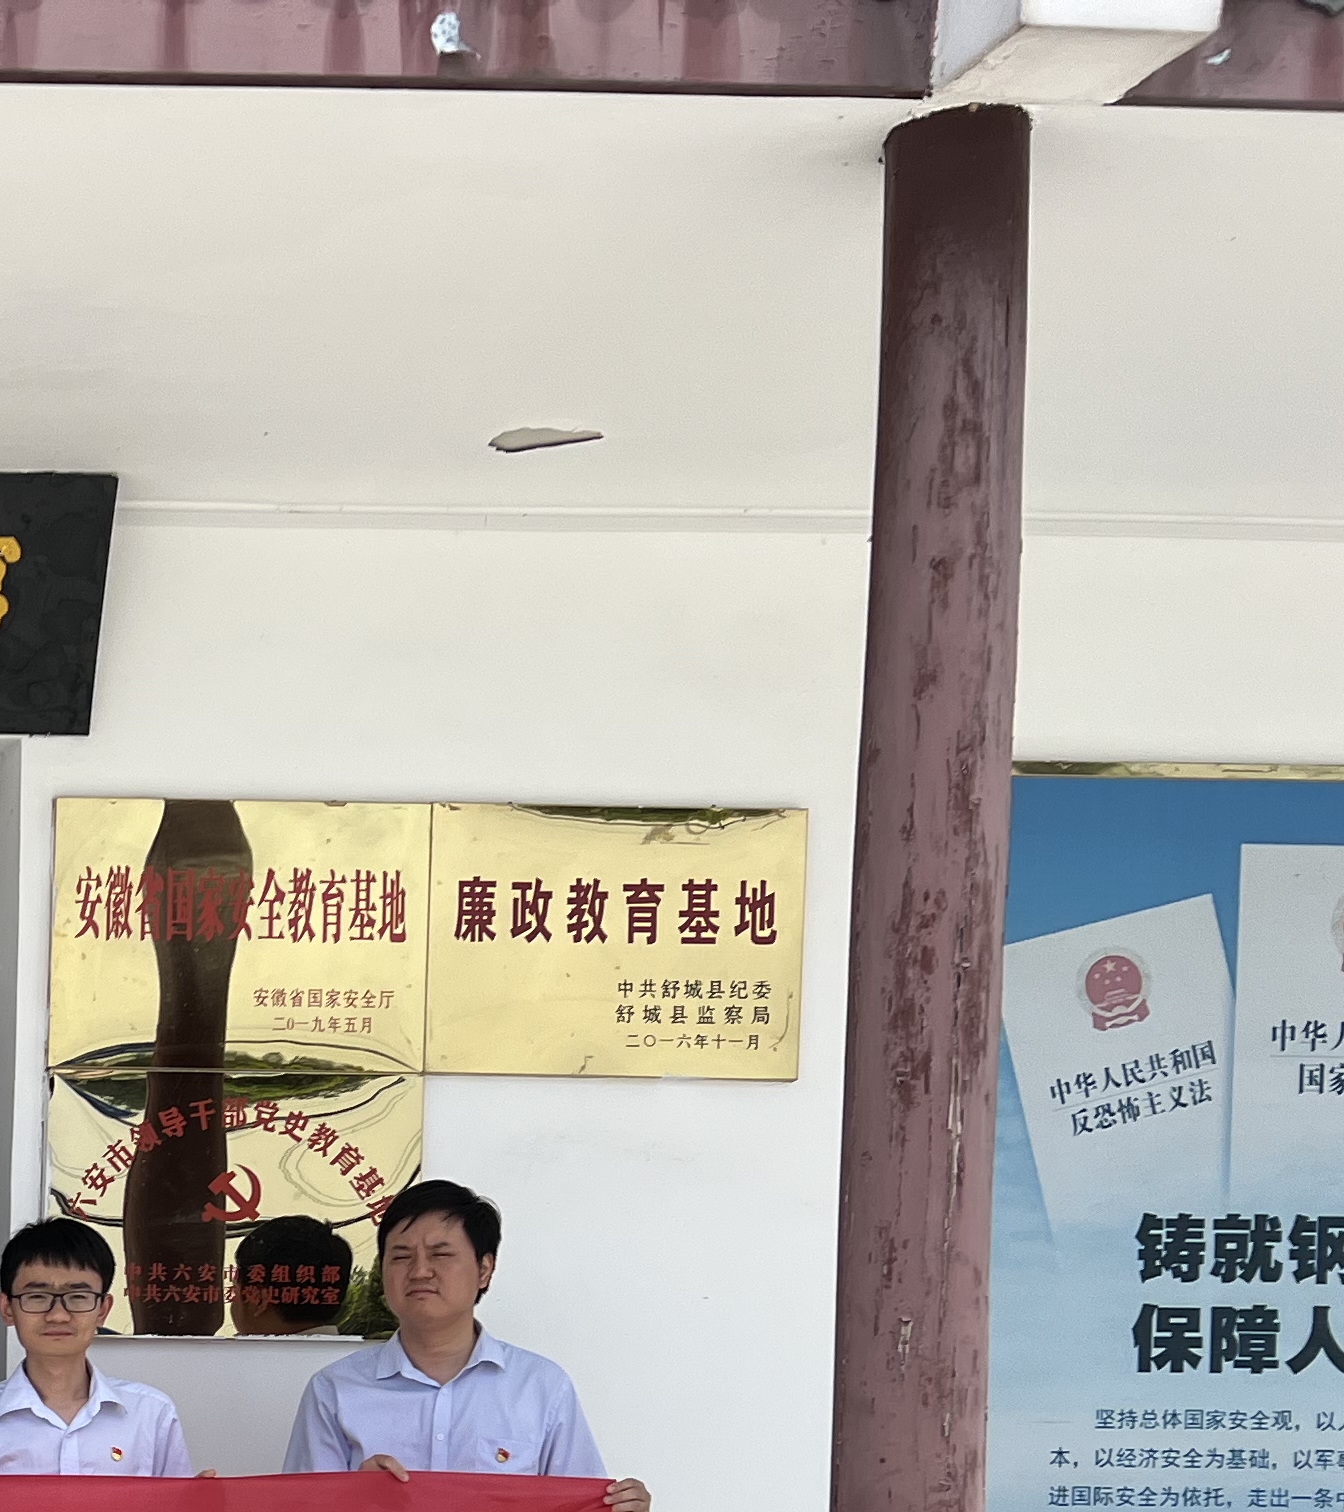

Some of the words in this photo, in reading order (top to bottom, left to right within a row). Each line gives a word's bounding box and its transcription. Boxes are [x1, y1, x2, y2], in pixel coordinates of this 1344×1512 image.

[75, 865, 407, 943] 安徽省国家安全教育基地
[454, 876, 778, 945] 廉政教育基地
[253, 988, 395, 1009] 安徽省国家安全厅
[615, 1005, 771, 1025] 舒城县监察局
[617, 979, 772, 1000] 中共舒城县纪委
[1049, 1040, 1217, 1105] 中华人民共和国
[1071, 1078, 1213, 1137] 反恐怖主义法
[124, 1262, 341, 1284] 中共六安市委组织部
[1132, 1303, 1344, 1375] 保障人
